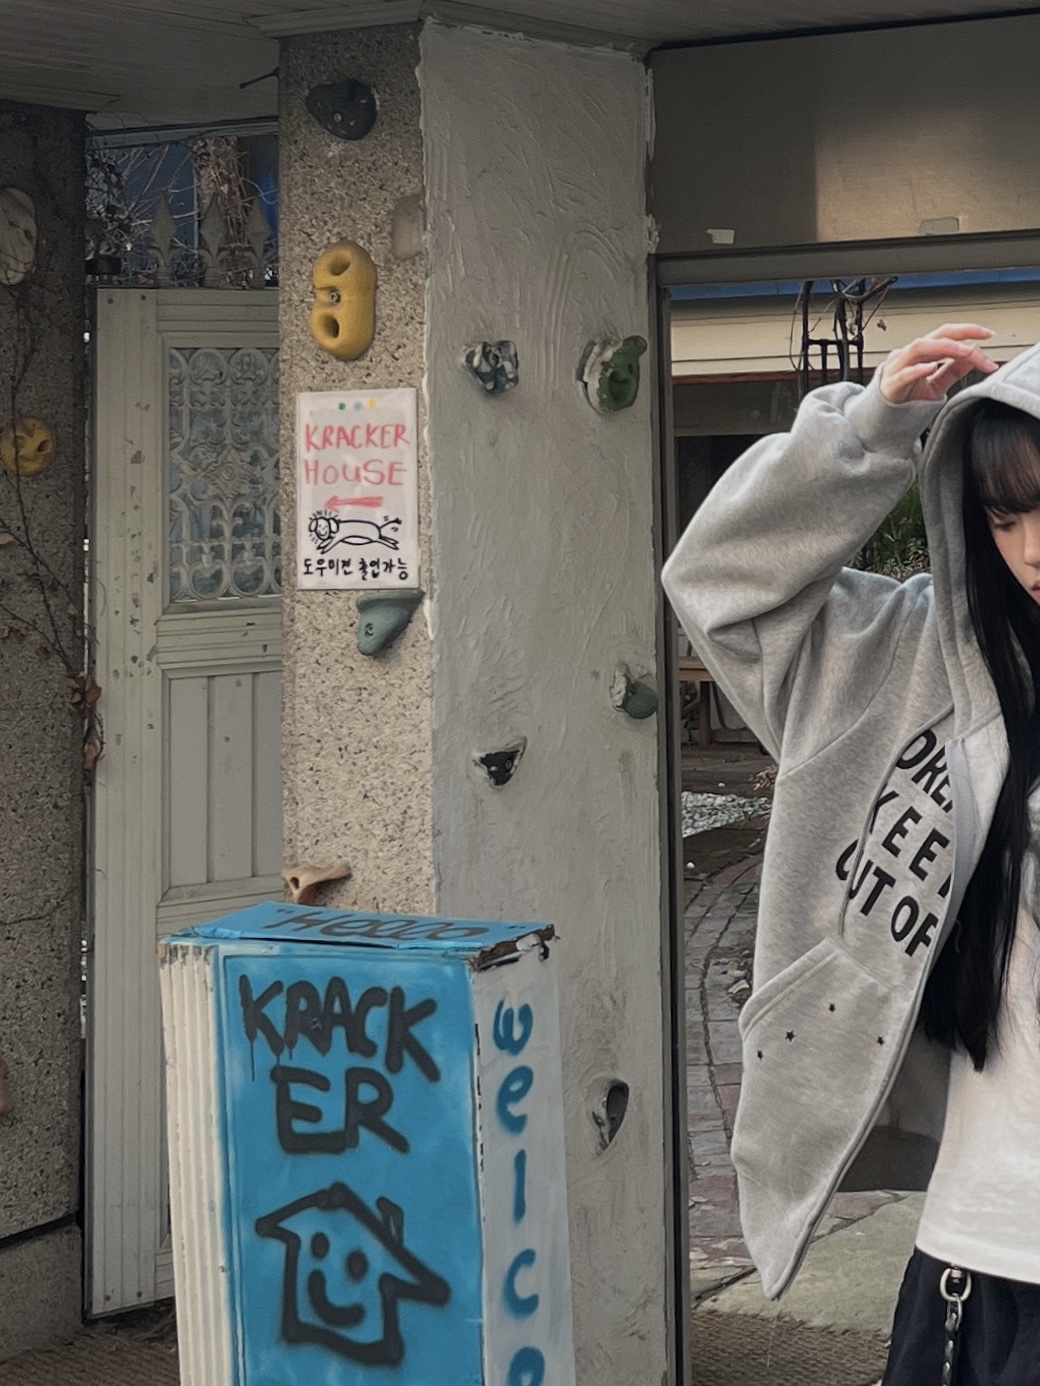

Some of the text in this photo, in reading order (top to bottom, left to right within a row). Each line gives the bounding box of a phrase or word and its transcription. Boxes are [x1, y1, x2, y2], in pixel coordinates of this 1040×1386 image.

[305, 424, 410, 452] KRACKER
[239, 974, 441, 1083] KRACK
[270, 1065, 411, 1156] ER
